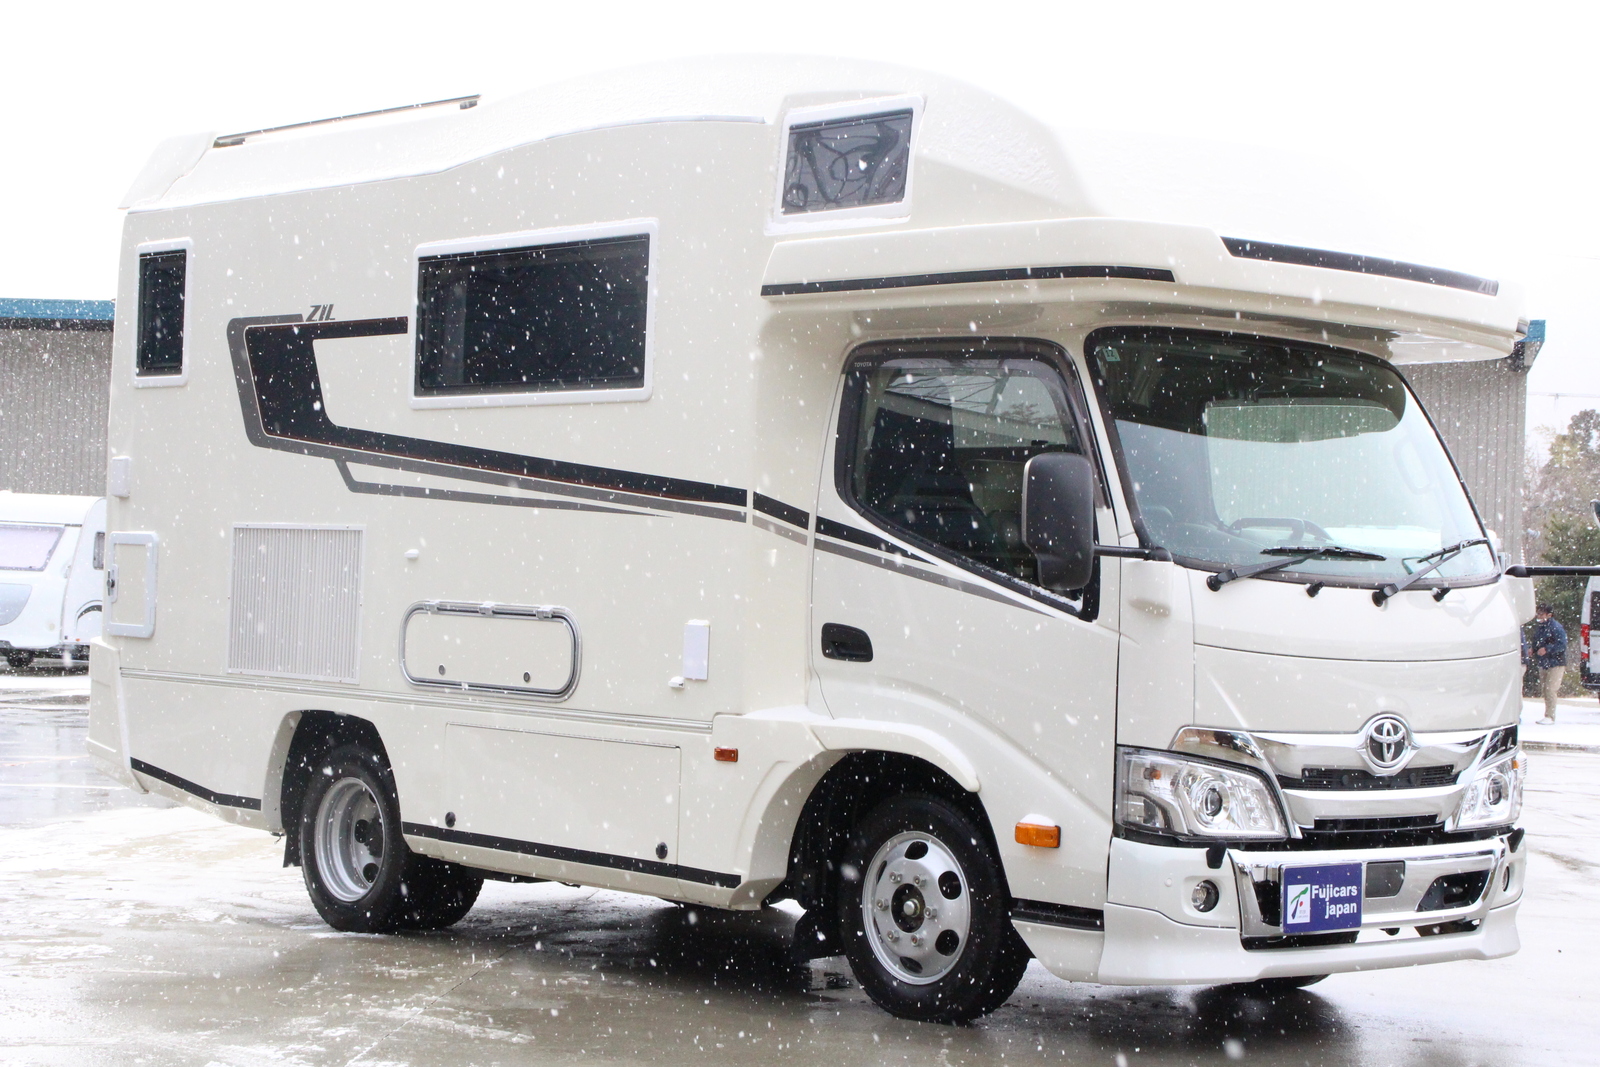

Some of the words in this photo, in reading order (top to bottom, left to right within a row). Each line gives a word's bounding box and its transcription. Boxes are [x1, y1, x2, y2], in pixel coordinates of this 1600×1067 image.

[305, 304, 335, 322] ZIL
[1311, 884, 1358, 901] Fujicars
[1325, 902, 1357, 919] japan
